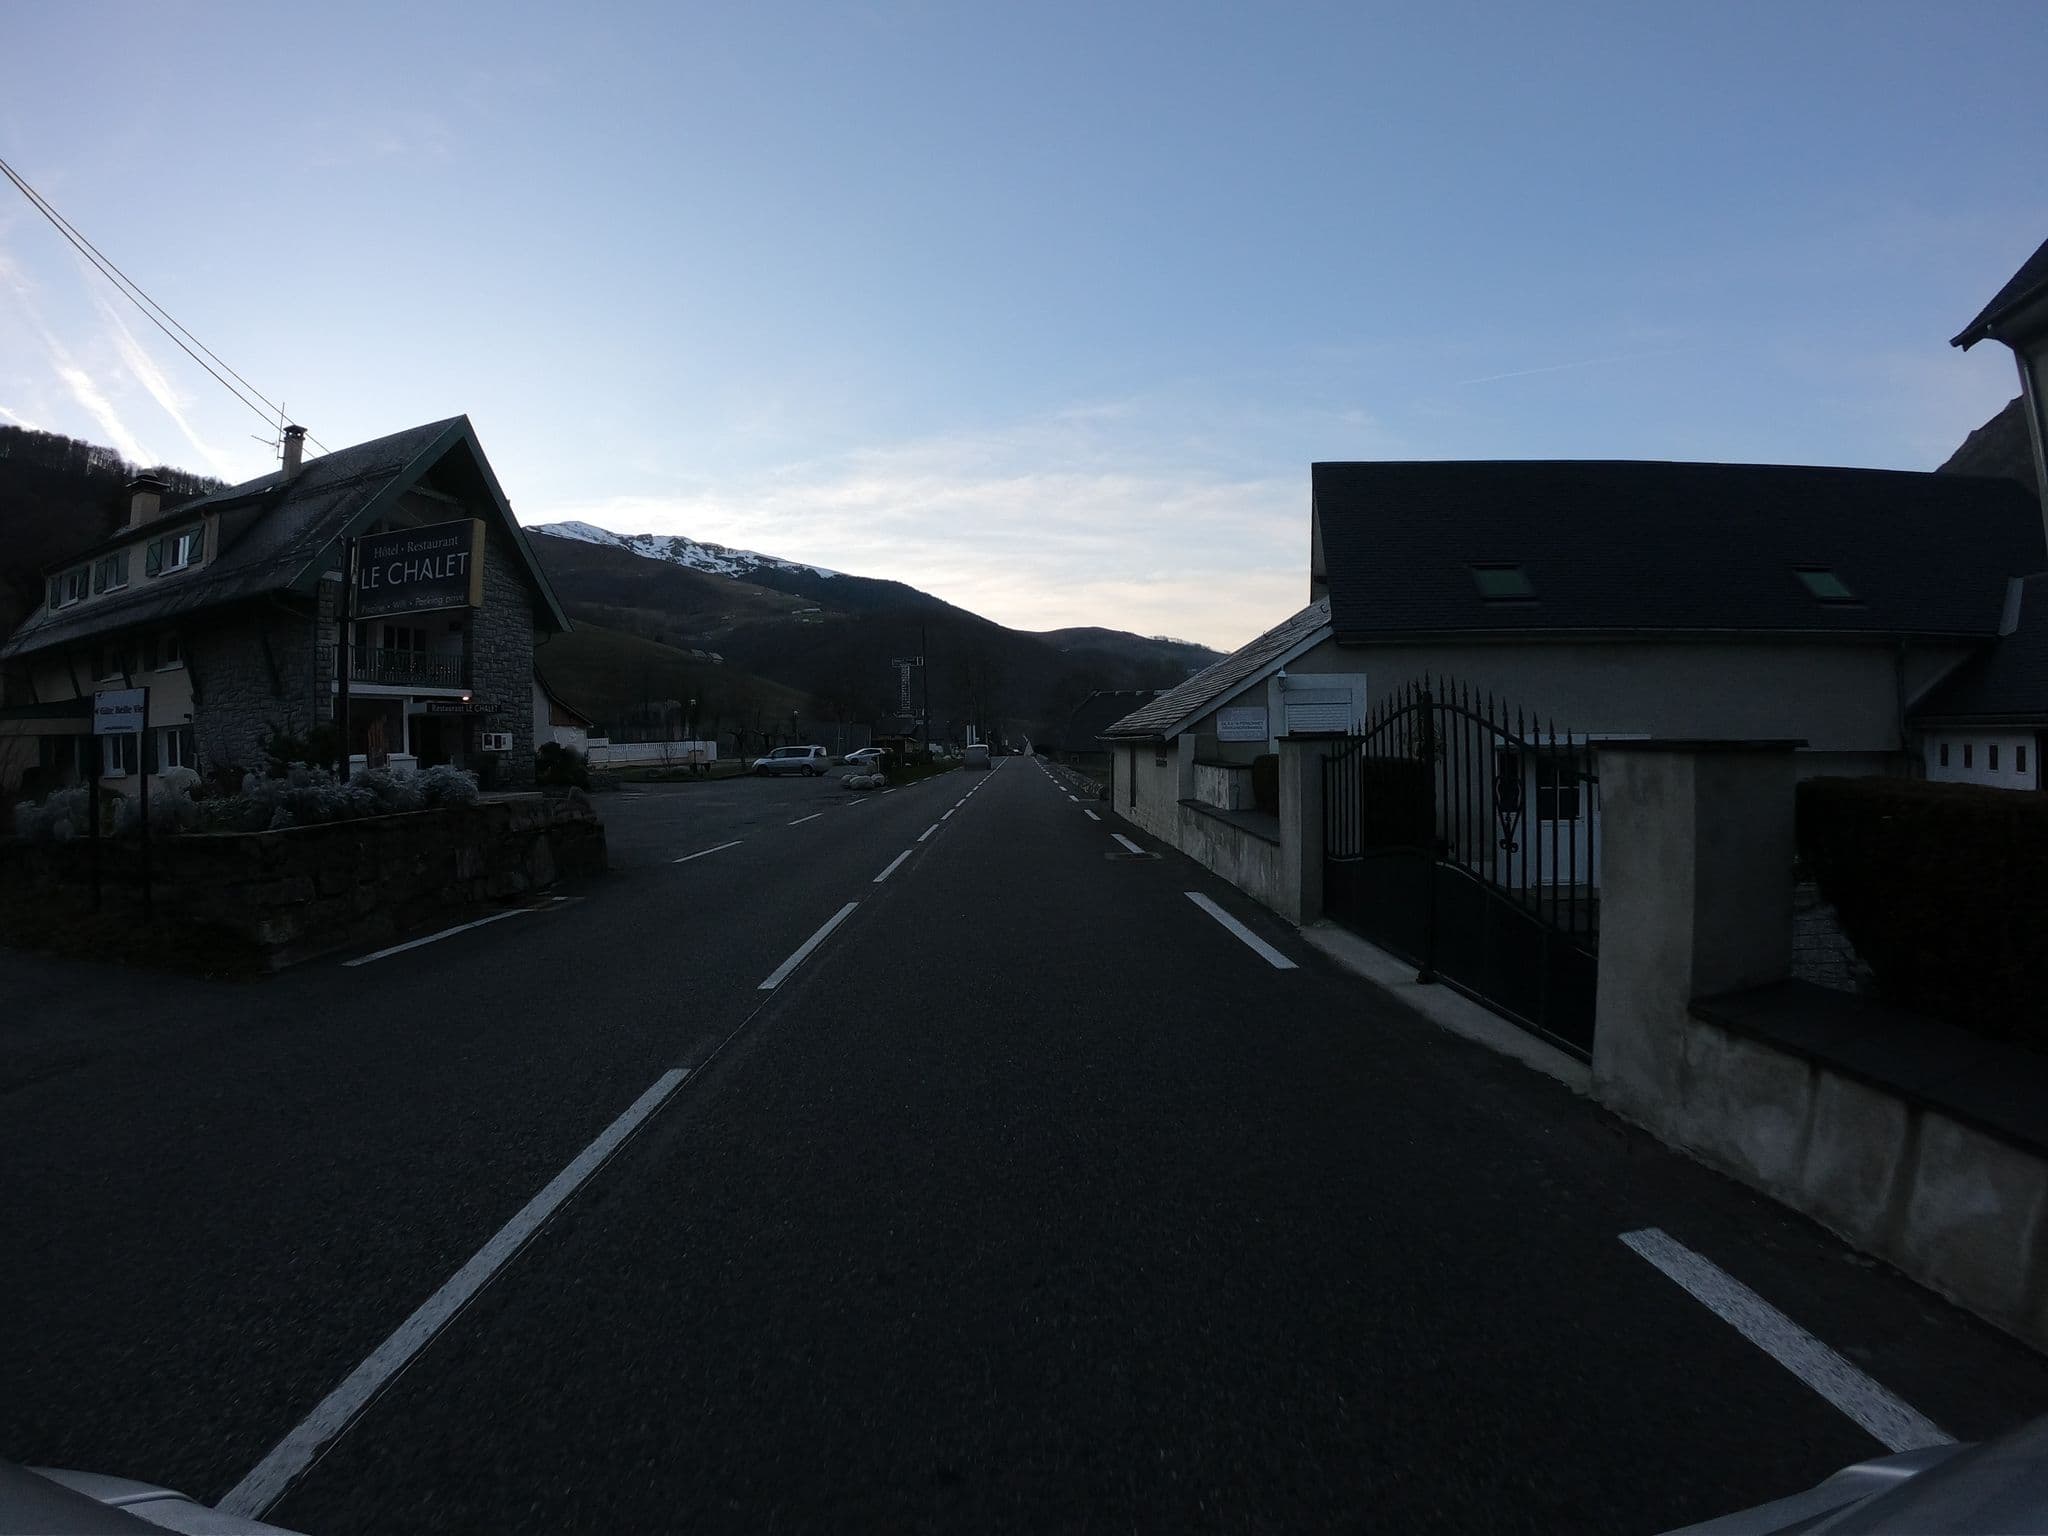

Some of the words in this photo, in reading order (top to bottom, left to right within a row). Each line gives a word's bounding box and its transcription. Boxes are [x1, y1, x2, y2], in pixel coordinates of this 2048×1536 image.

[373, 543, 399, 559] Hôtel
[407, 536, 458, 552] Restaurant
[361, 566, 380, 589] LE
[388, 552, 469, 584] CHALET
[431, 703, 464, 712] Restaurant
[474, 703, 498, 713] CHALET
